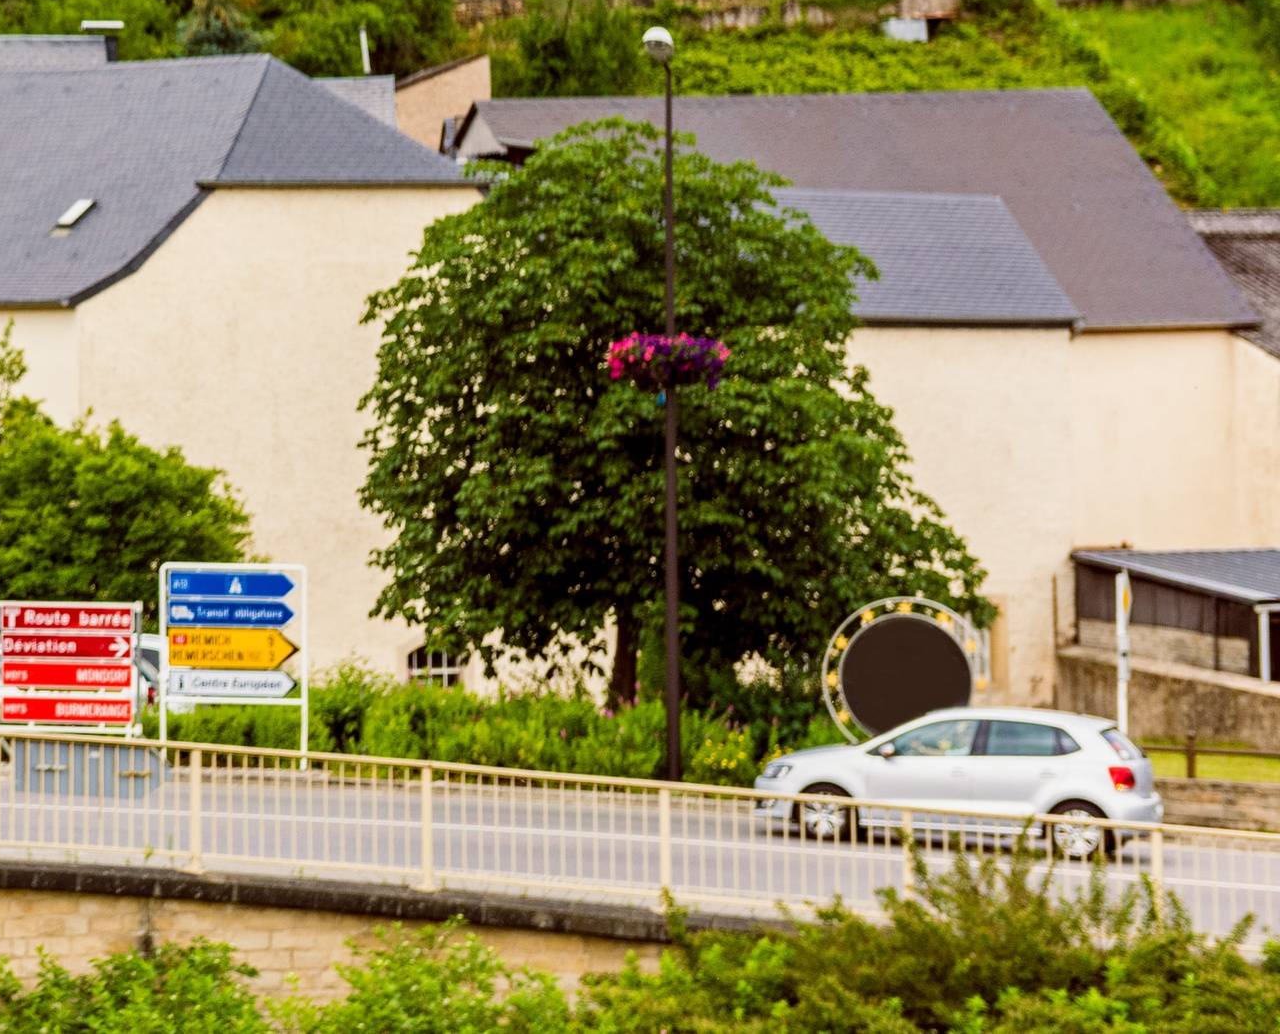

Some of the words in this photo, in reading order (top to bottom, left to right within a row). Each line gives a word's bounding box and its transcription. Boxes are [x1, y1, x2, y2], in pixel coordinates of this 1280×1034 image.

[23, 609, 71, 625] Route
[78, 611, 131, 626] barrée
[3, 638, 77, 653] Déviation
